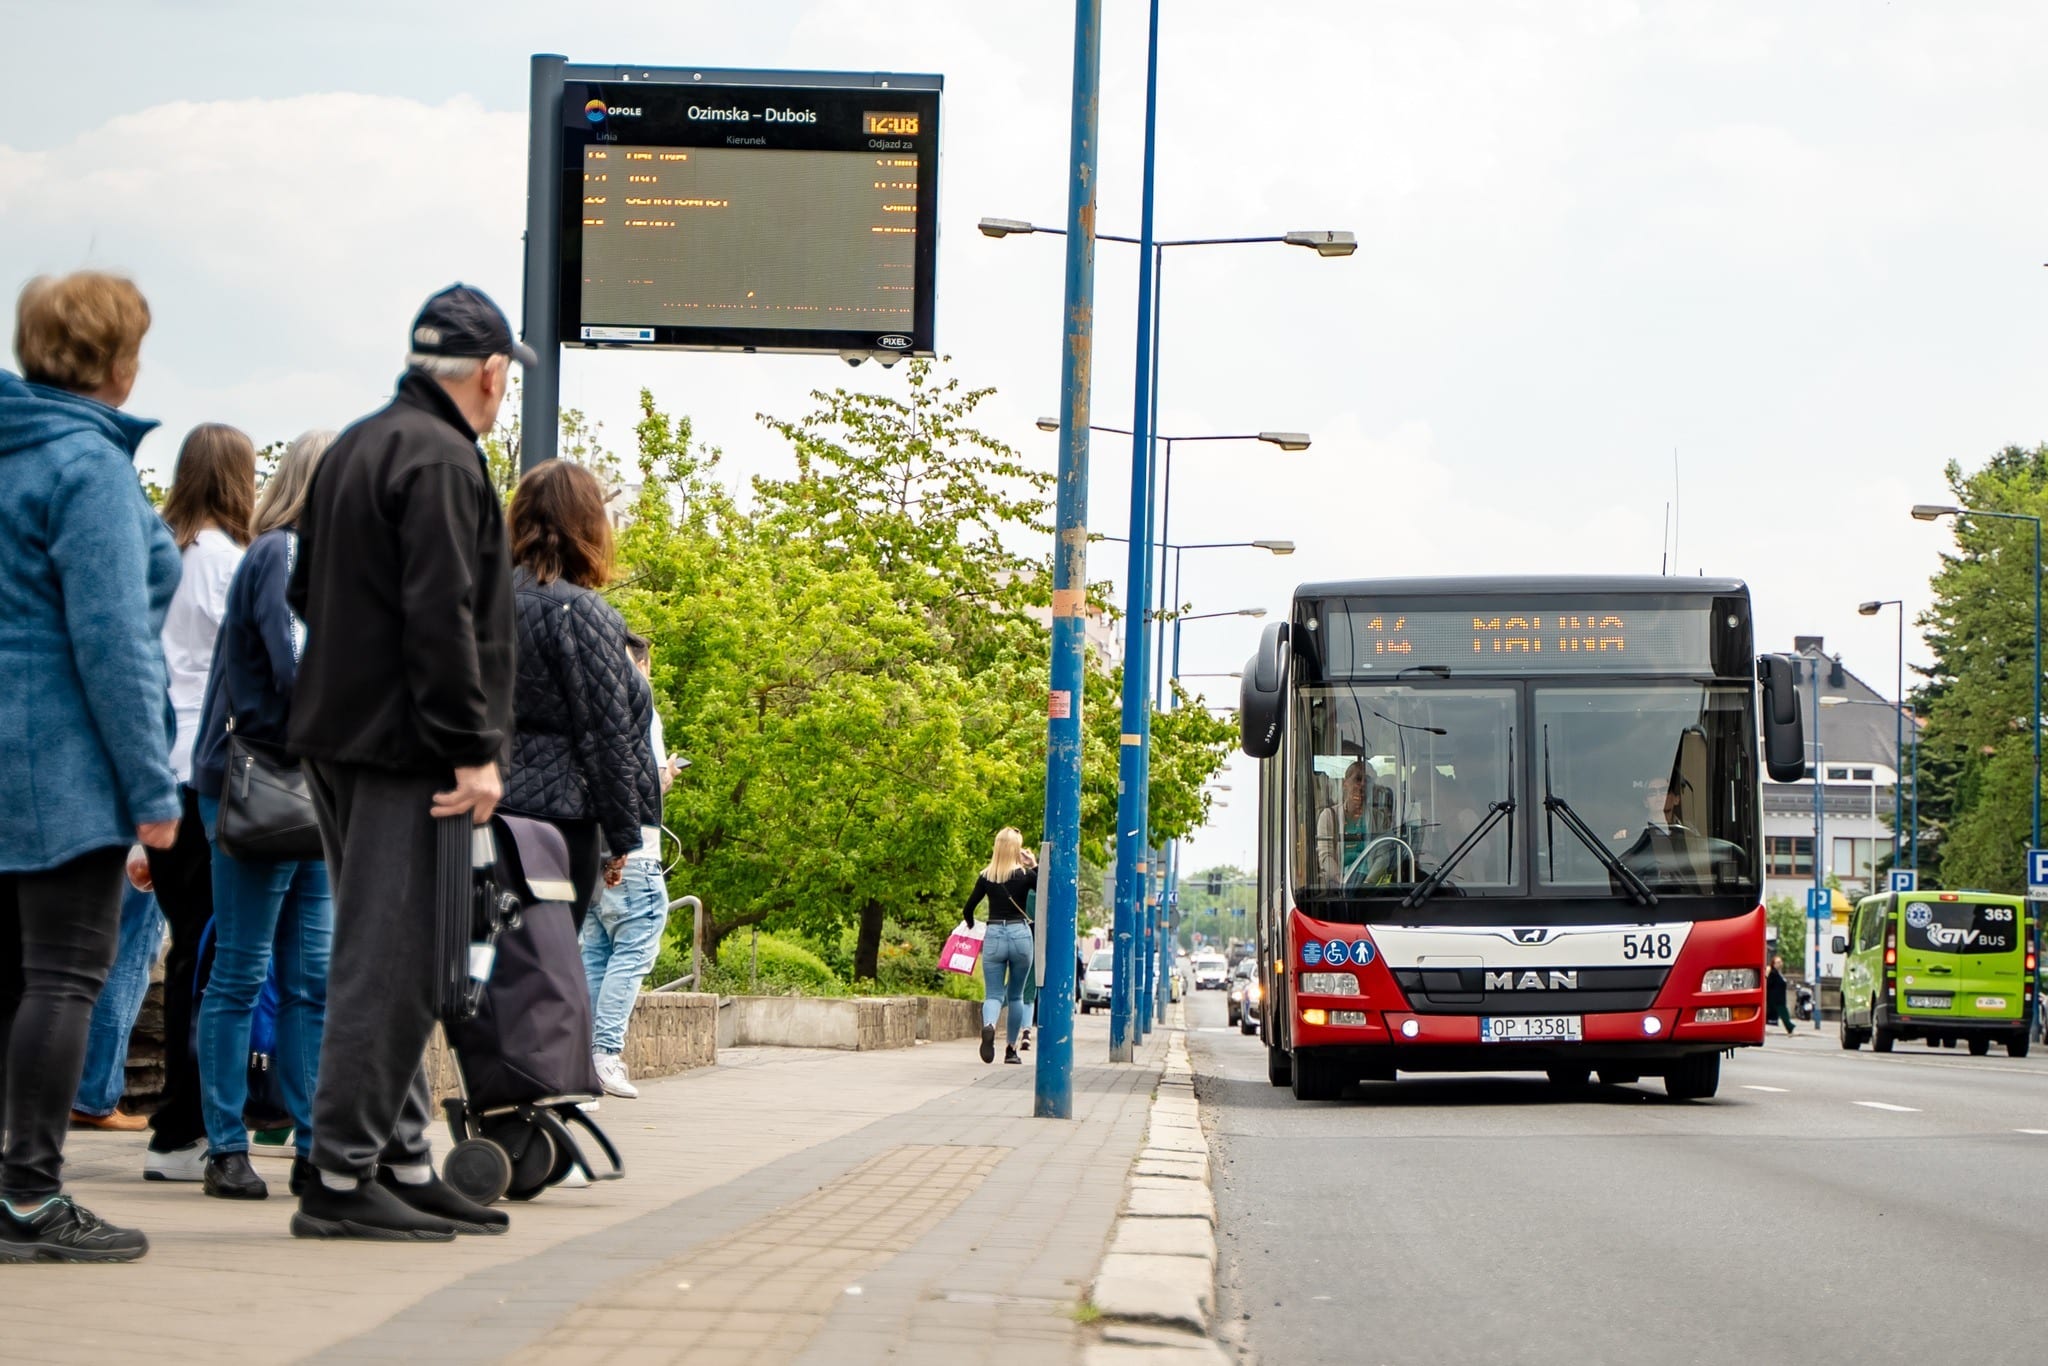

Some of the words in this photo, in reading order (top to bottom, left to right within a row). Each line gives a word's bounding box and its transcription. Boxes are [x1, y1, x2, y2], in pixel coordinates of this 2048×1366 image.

[607, 107, 642, 117] OPOLE
[687, 106, 750, 121] Ozimska
[765, 108, 817, 123] Dubois
[596, 132, 618, 141] Linia
[726, 135, 767, 145] Kierunek
[868, 138, 901, 150] Odjazd
[902, 141, 913, 149] za
[882, 337, 907, 346] PIXEL
[1897, 874, 1910, 891] P
[1984, 908, 2013, 921] 363
[1936, 928, 1980, 945] GTV
[1979, 935, 2006, 946] BUS
[1623, 933, 1672, 960] 548
[1485, 970, 1578, 990] MAN
[1493, 1019, 1516, 1036] OP
[1524, 1018, 1577, 1036] 1358L
